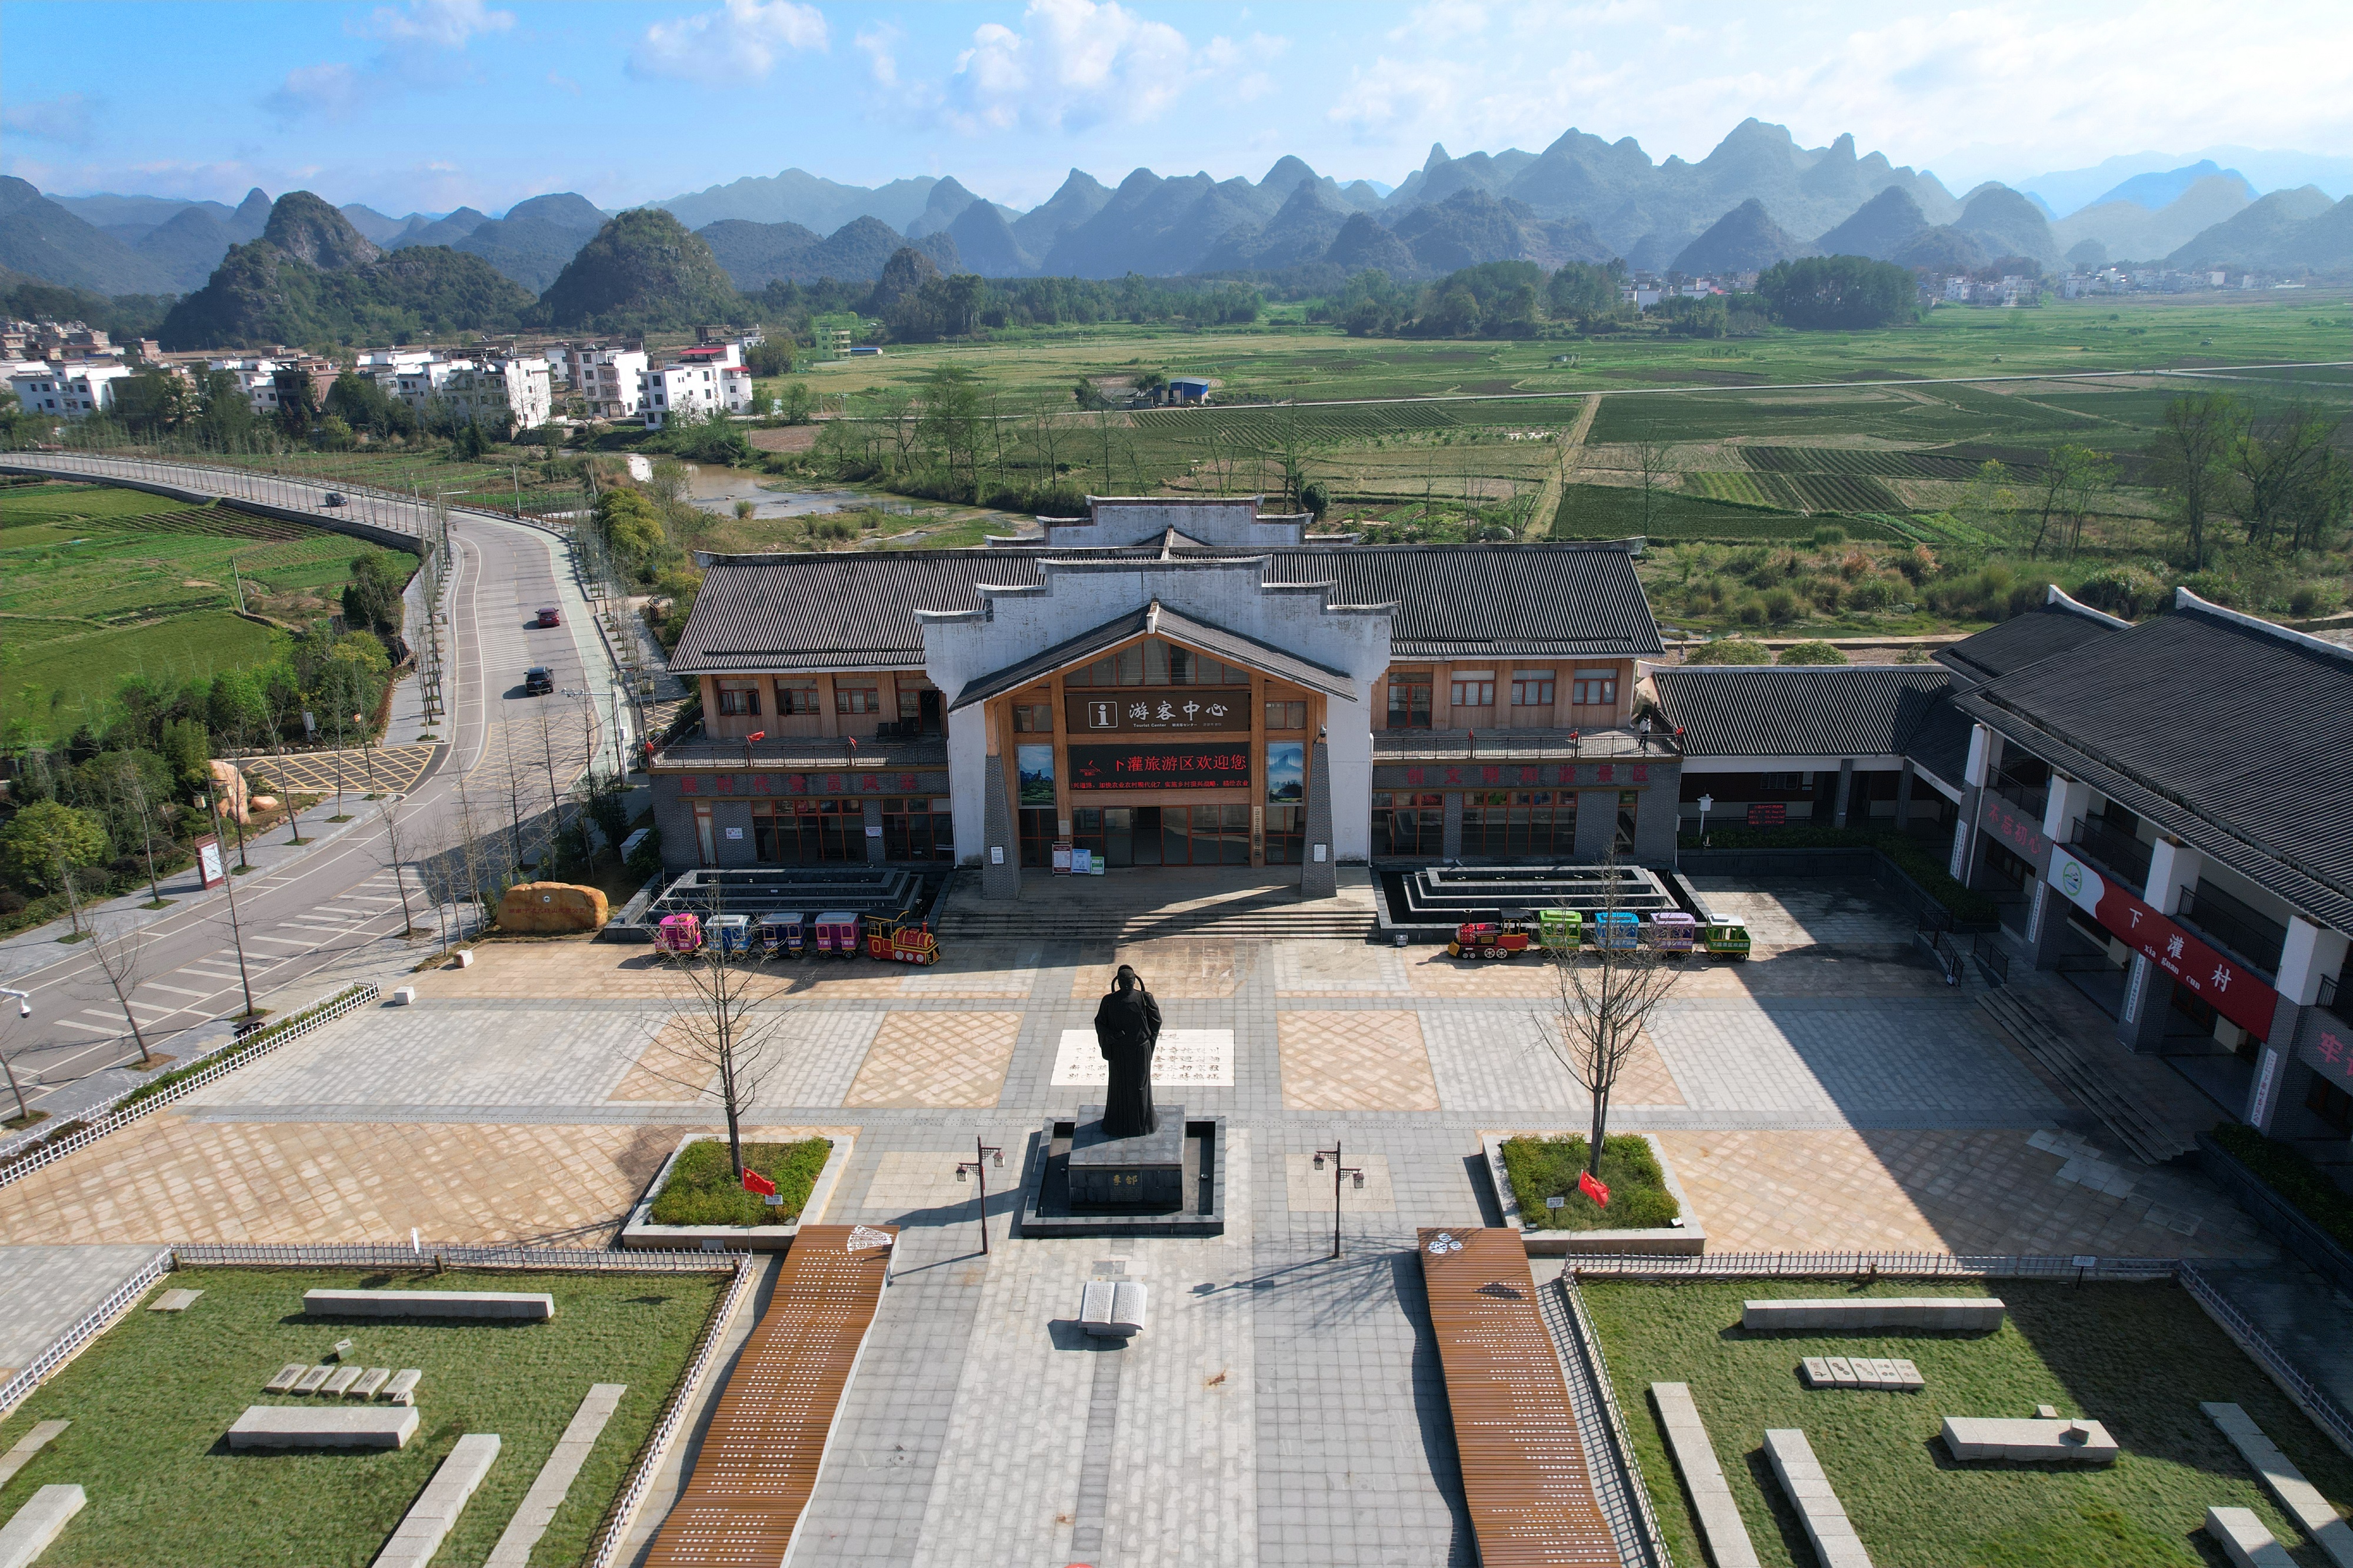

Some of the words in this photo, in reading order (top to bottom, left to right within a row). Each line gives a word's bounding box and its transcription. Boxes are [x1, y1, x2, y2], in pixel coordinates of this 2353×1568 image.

[1129, 700, 1229, 722] 游客中心
[681, 773, 918, 794] 展时代党员风采
[1407, 764, 1649, 785] 创文明和谐景区
[1988, 803, 2041, 855] 不忘初心
[2129, 908, 2232, 993] 下灌村
[2144, 944, 2157, 958] xia
[2161, 955, 2180, 976] guan
[2185, 974, 2201, 990] cun
